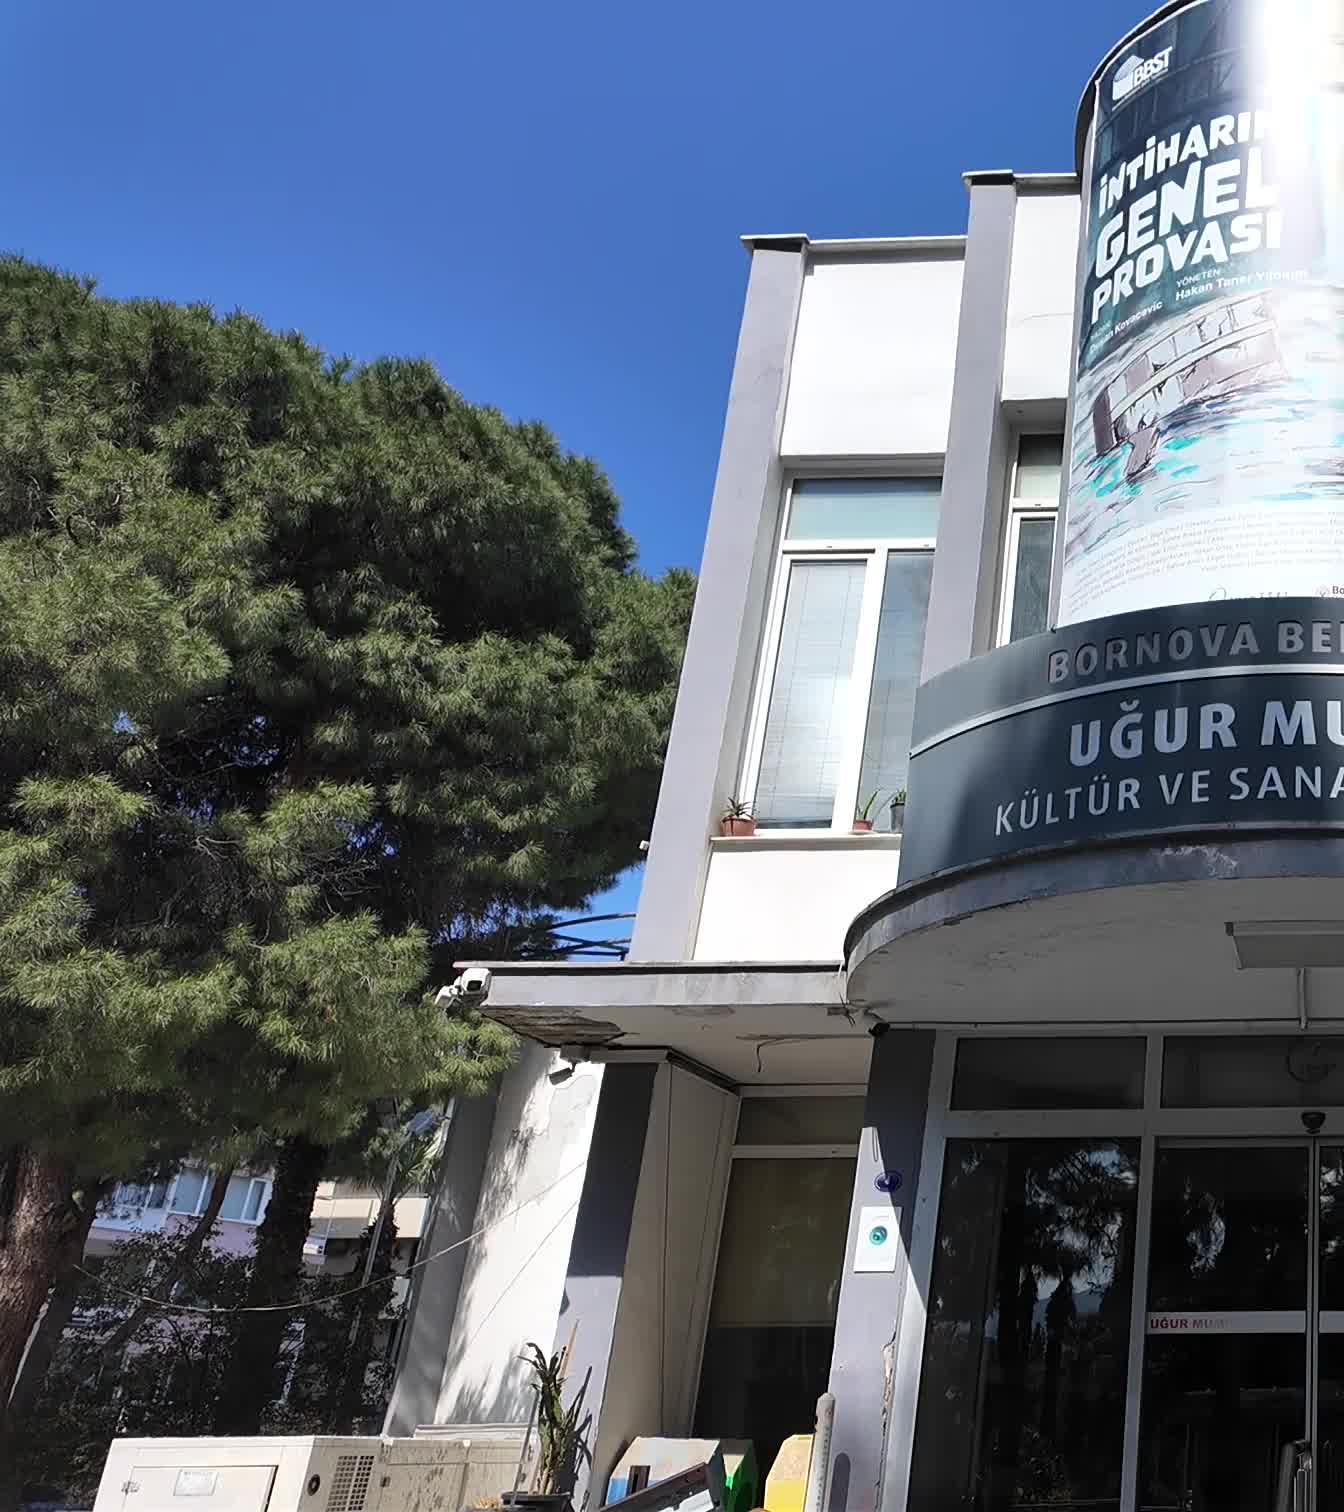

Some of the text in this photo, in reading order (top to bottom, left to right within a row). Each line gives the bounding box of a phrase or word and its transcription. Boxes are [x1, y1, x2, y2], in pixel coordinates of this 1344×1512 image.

[1134, 46, 1173, 88] BBST
[1096, 147, 1279, 278] GENEL
[1091, 211, 1281, 325] PROVASI
[1175, 282, 1214, 301] Hakan
[1176, 269, 1221, 288] YÖNETEN
[1048, 620, 1261, 684] BORNOVA
[1069, 700, 1238, 767] UĞUR
[995, 774, 1141, 837] KÜLTÜR
[1158, 769, 1211, 806] VE
[1150, 1316, 1189, 1329] UĞUR
